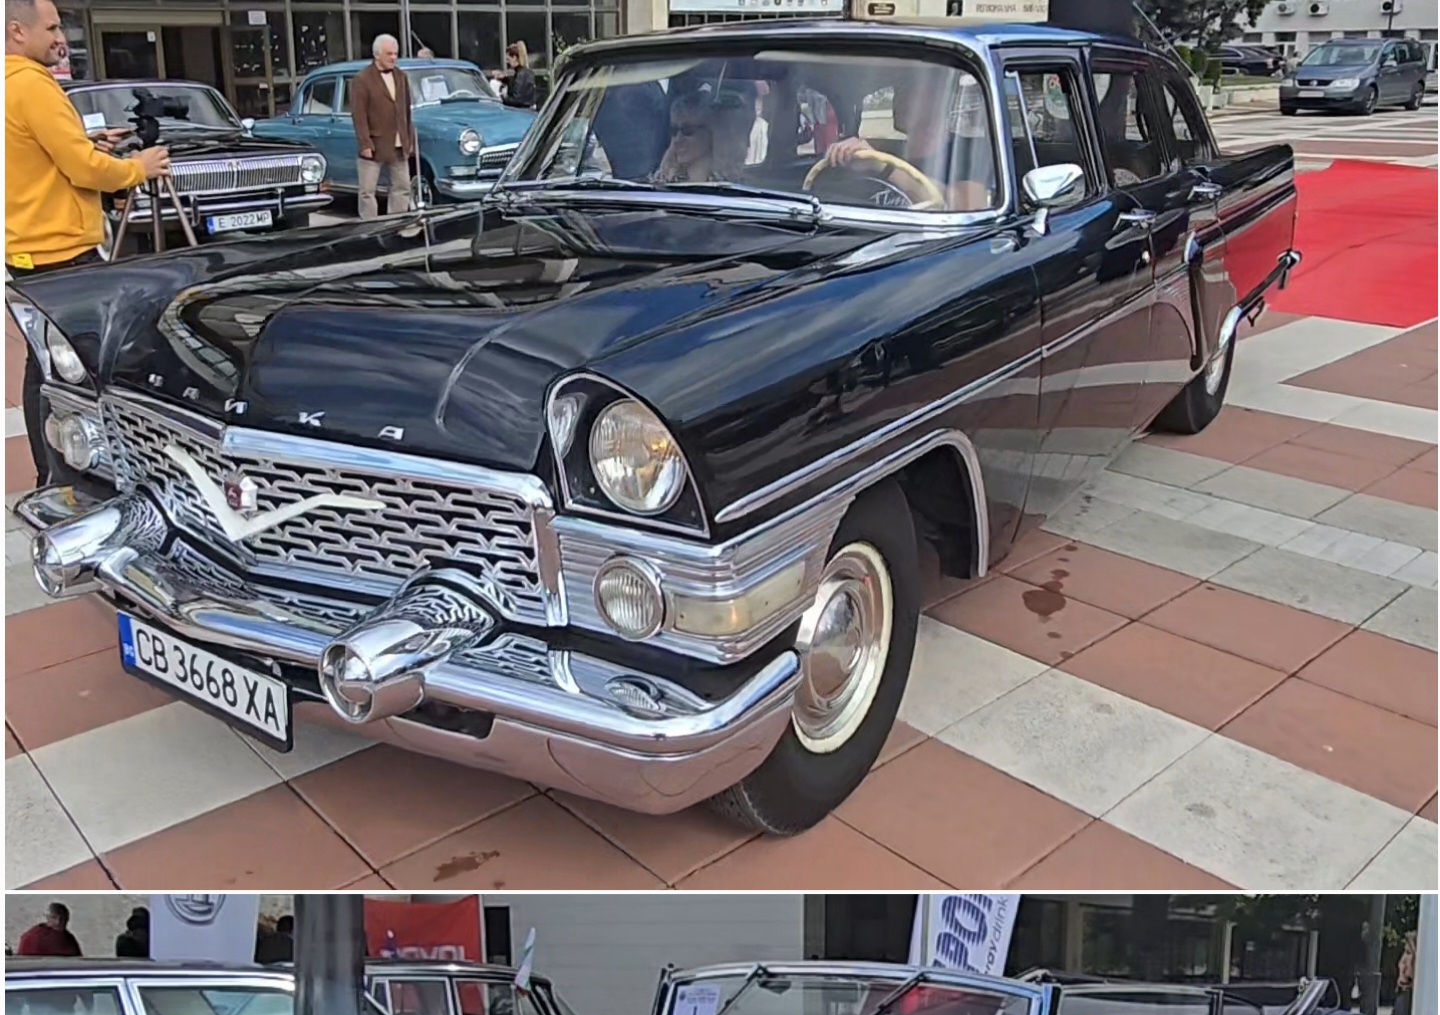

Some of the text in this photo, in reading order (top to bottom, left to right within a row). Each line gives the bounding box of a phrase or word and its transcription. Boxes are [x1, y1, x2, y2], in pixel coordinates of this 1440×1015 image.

[136, 629, 280, 731] CB 3668 XA
